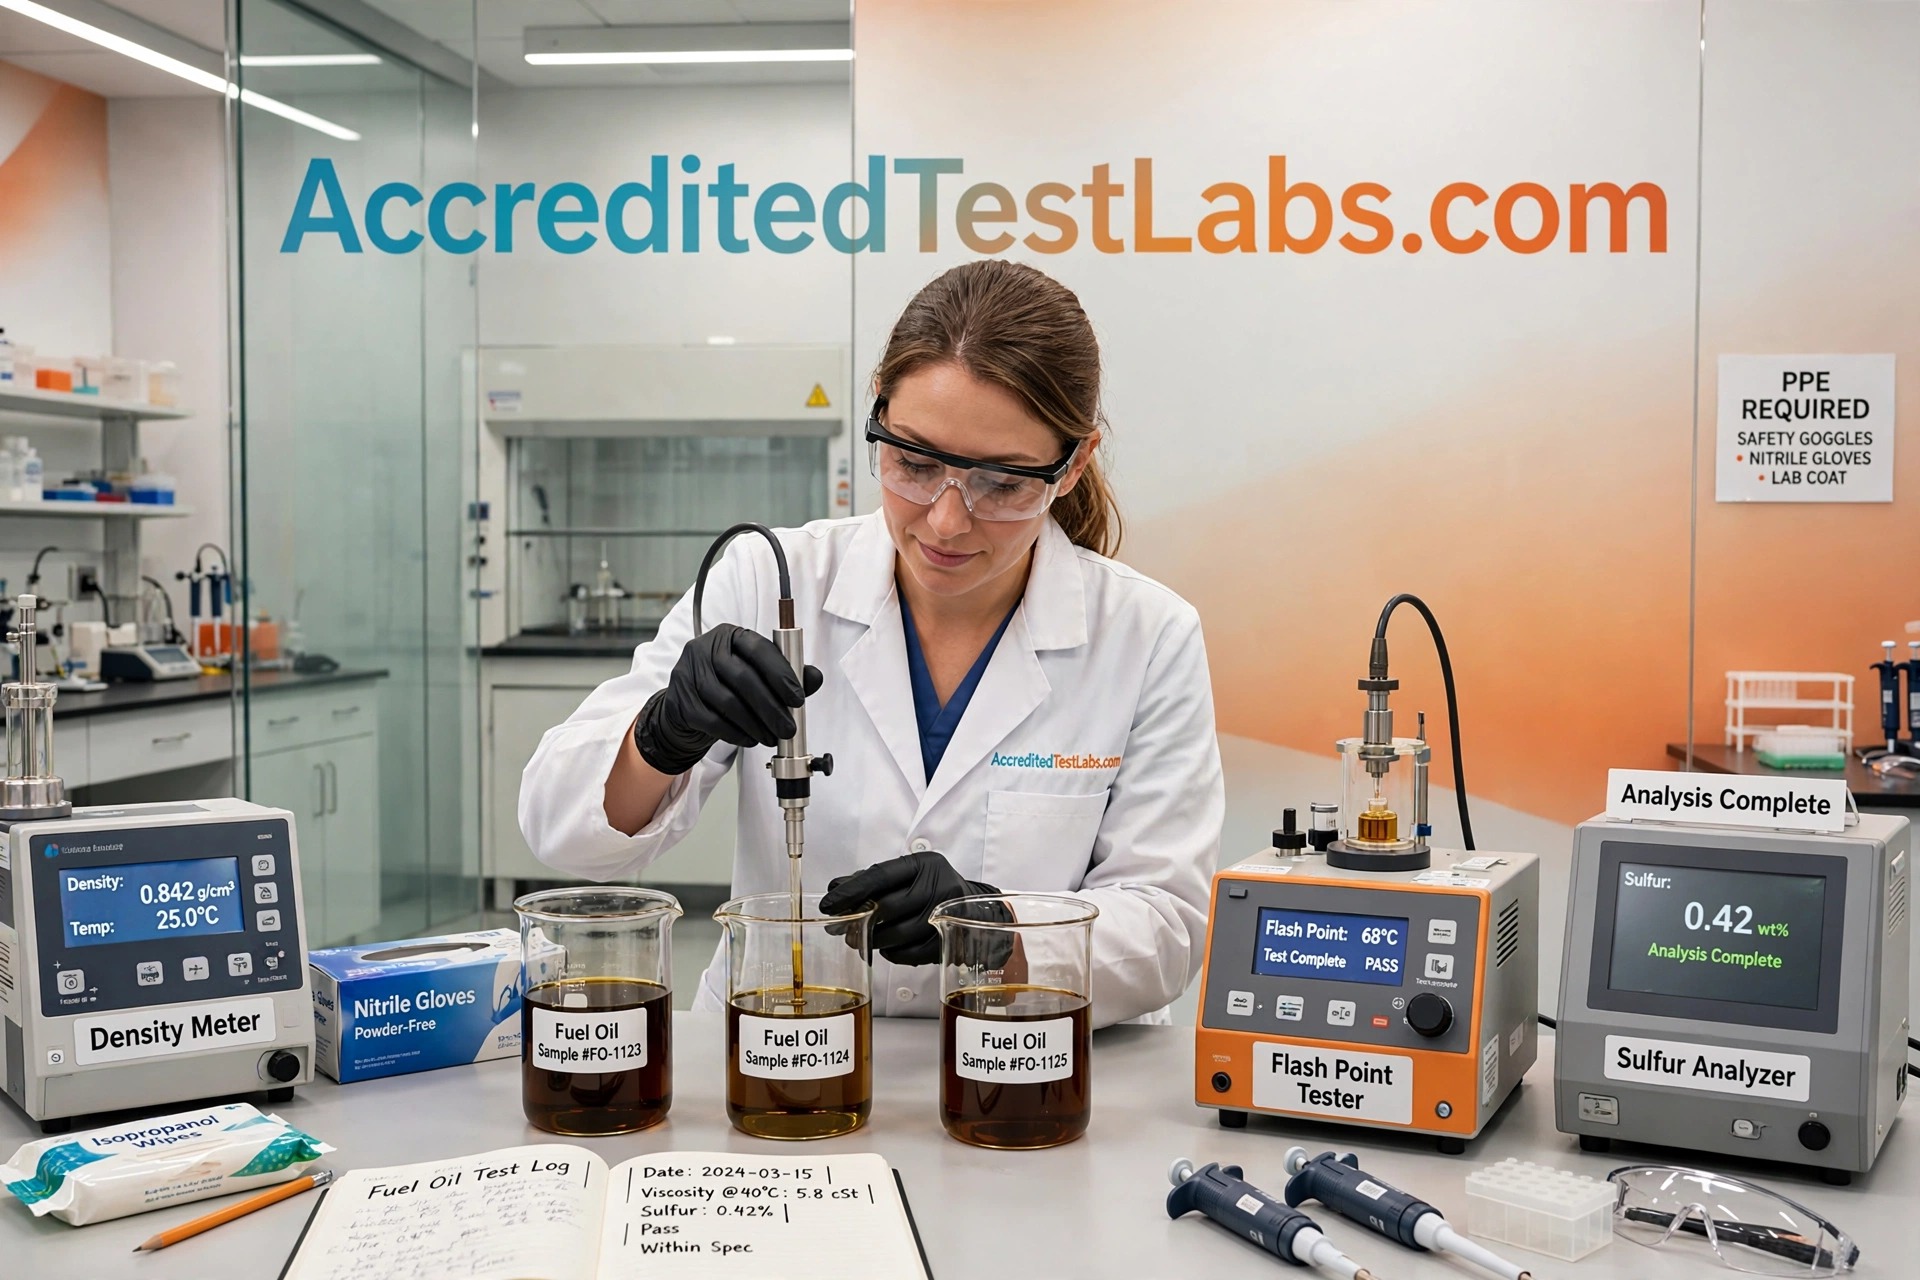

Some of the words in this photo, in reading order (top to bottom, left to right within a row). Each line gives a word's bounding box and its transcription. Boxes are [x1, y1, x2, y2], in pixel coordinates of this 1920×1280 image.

[280, 154, 1669, 257] AccreditedTestLabs.com
[1782, 371, 1830, 392] PPE
[1742, 398, 1870, 422] REQUIRED
[1737, 431, 1795, 446] SAFETY
[1799, 431, 1873, 446] GOGGLES
[1749, 451, 1808, 465] NITRILE
[1812, 451, 1872, 466] GLOVES
[1772, 471, 1802, 485] LAB
[1806, 470, 1847, 485] COAT
[991, 752, 1121, 769] AccreditedTestLabs.com
[1621, 783, 1713, 811] Analysis
[1719, 788, 1831, 817] Complete
[67, 875, 124, 892] Density:
[140, 881, 194, 905] 0.842
[1624, 871, 1671, 889] Sulfur:
[70, 920, 115, 937] Temp:
[156, 905, 219, 930] 25.0°C
[1684, 901, 1754, 935] 0.42
[1758, 923, 1789, 938] wt%
[1265, 920, 1302, 938] Flash
[1306, 924, 1348, 942] Point:
[1361, 928, 1398, 946] 68°C
[1264, 948, 1287, 963] Test
[1290, 951, 1347, 969] Complete
[1365, 957, 1398, 973] PASS
[1647, 942, 1708, 962] Analysis
[1711, 948, 1782, 969] Complete
[354, 994, 411, 1019] Nitrile
[416, 989, 476, 1011] Gloves
[90, 1021, 184, 1052] Density
[191, 1010, 262, 1038] Meter
[354, 1018, 436, 1040] Powder-Free
[555, 1022, 589, 1041] Fuel
[593, 1023, 619, 1039] Oil
[763, 1029, 799, 1047] Fuel
[804, 1029, 829, 1046] Oil
[980, 1031, 1018, 1050] Fuel
[1022, 1032, 1046, 1051] Oil
[538, 1044, 579, 1061] Sample
[581, 1044, 642, 1061] #FO-1123
[745, 1050, 788, 1070] Sample
[791, 1050, 850, 1068] #FO-1124
[962, 1053, 1005, 1073] Sample
[1009, 1056, 1068, 1072] #FO-1125
[1272, 1052, 1328, 1079] Flash
[1335, 1061, 1394, 1086] Point
[1617, 1047, 1686, 1075] Sulfur
[1692, 1055, 1796, 1088] Analyzer
[1297, 1082, 1364, 1110] Tester
[92, 1114, 219, 1147] Isopropanol
[131, 1130, 204, 1151] Wipes
[367, 1179, 418, 1200] Fuel
[429, 1171, 462, 1190] Oil
[474, 1162, 520, 1182] Test
[531, 1159, 570, 1176] Log
[643, 1166, 692, 1180] Date:
[702, 1167, 813, 1181] 2024-03-15
[641, 1185, 715, 1202] Viscosity
[796, 1186, 826, 1200] 5.8
[831, 1185, 860, 1202] cSt
[716, 1204, 774, 1219] 0.42%
[641, 1222, 680, 1237] Pass
[640, 1240, 701, 1256] Within
[710, 1240, 754, 1257] Spec
